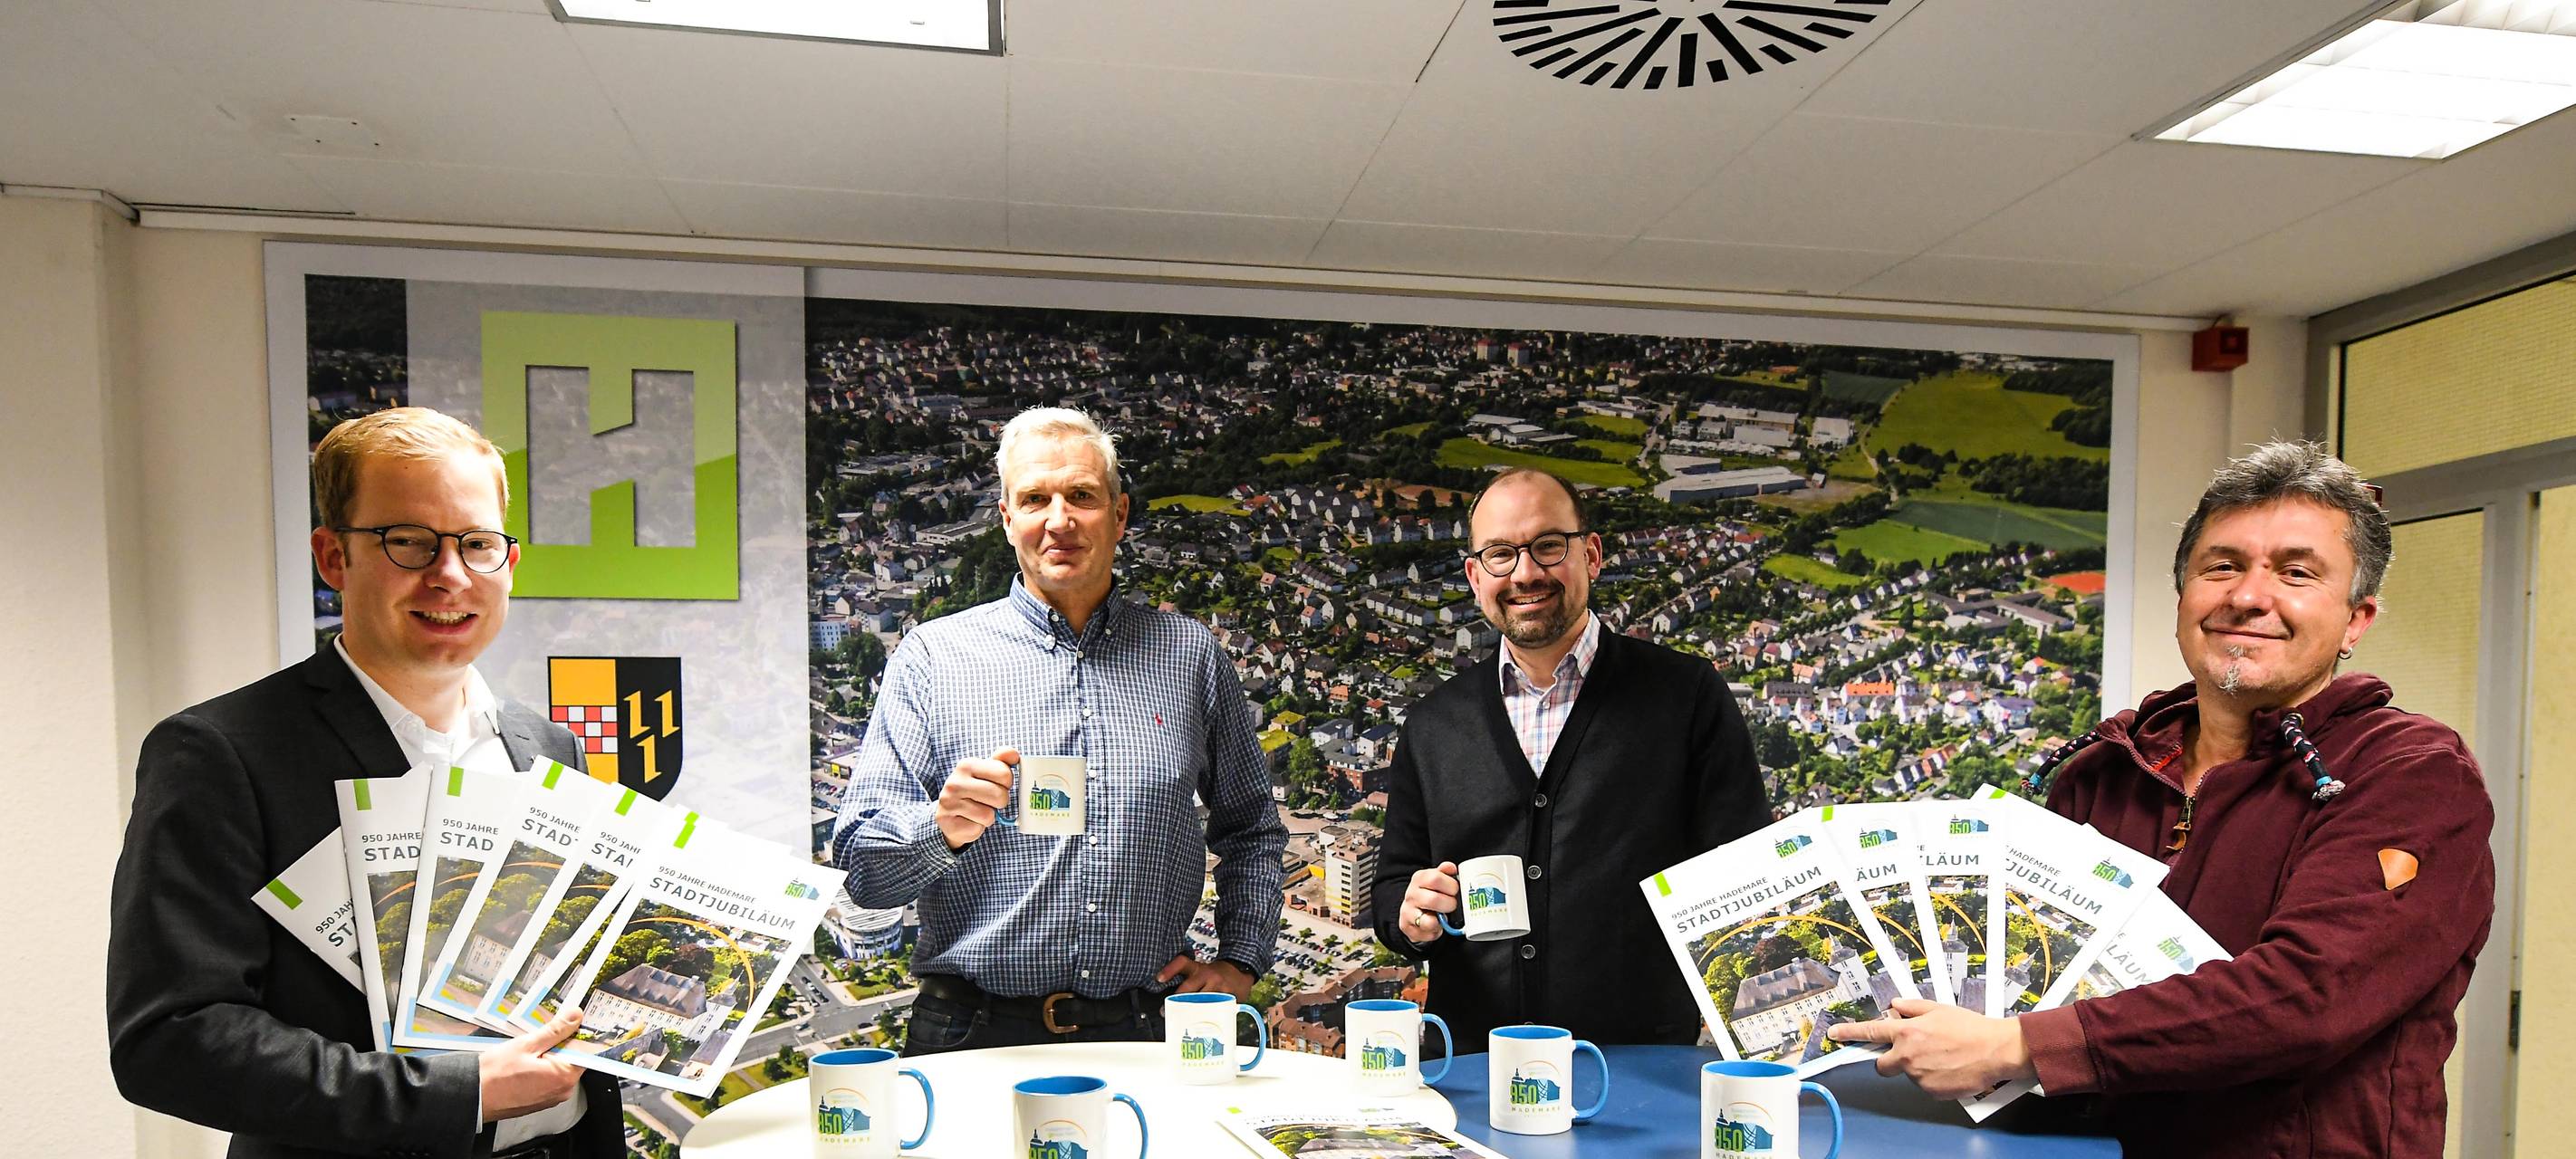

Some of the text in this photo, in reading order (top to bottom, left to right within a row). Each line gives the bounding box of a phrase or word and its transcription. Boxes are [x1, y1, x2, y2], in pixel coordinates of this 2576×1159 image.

[442, 818, 498, 836] 950 JAHRE
[522, 819, 579, 847] STAD
[529, 807, 582, 834] 950 JAHRE
[362, 831, 422, 843] 950 JAHRE
[601, 831, 618, 844] 950
[591, 842, 634, 868] STA
[658, 866, 676, 876] 950
[677, 872, 706, 888] JAHRE
[2005, 857, 2103, 915] JUBILÄUM
[649, 876, 796, 931] STADTJUBILÄUM
[1677, 866, 1822, 934] STADTJUBILÄUM
[1690, 897, 1717, 914] JAHRE
[1719, 876, 1768, 902] HADEMARE
[315, 916, 335, 934] 950
[1510, 1084, 1537, 1105] 950
[1715, 1125, 1743, 1153] 950
